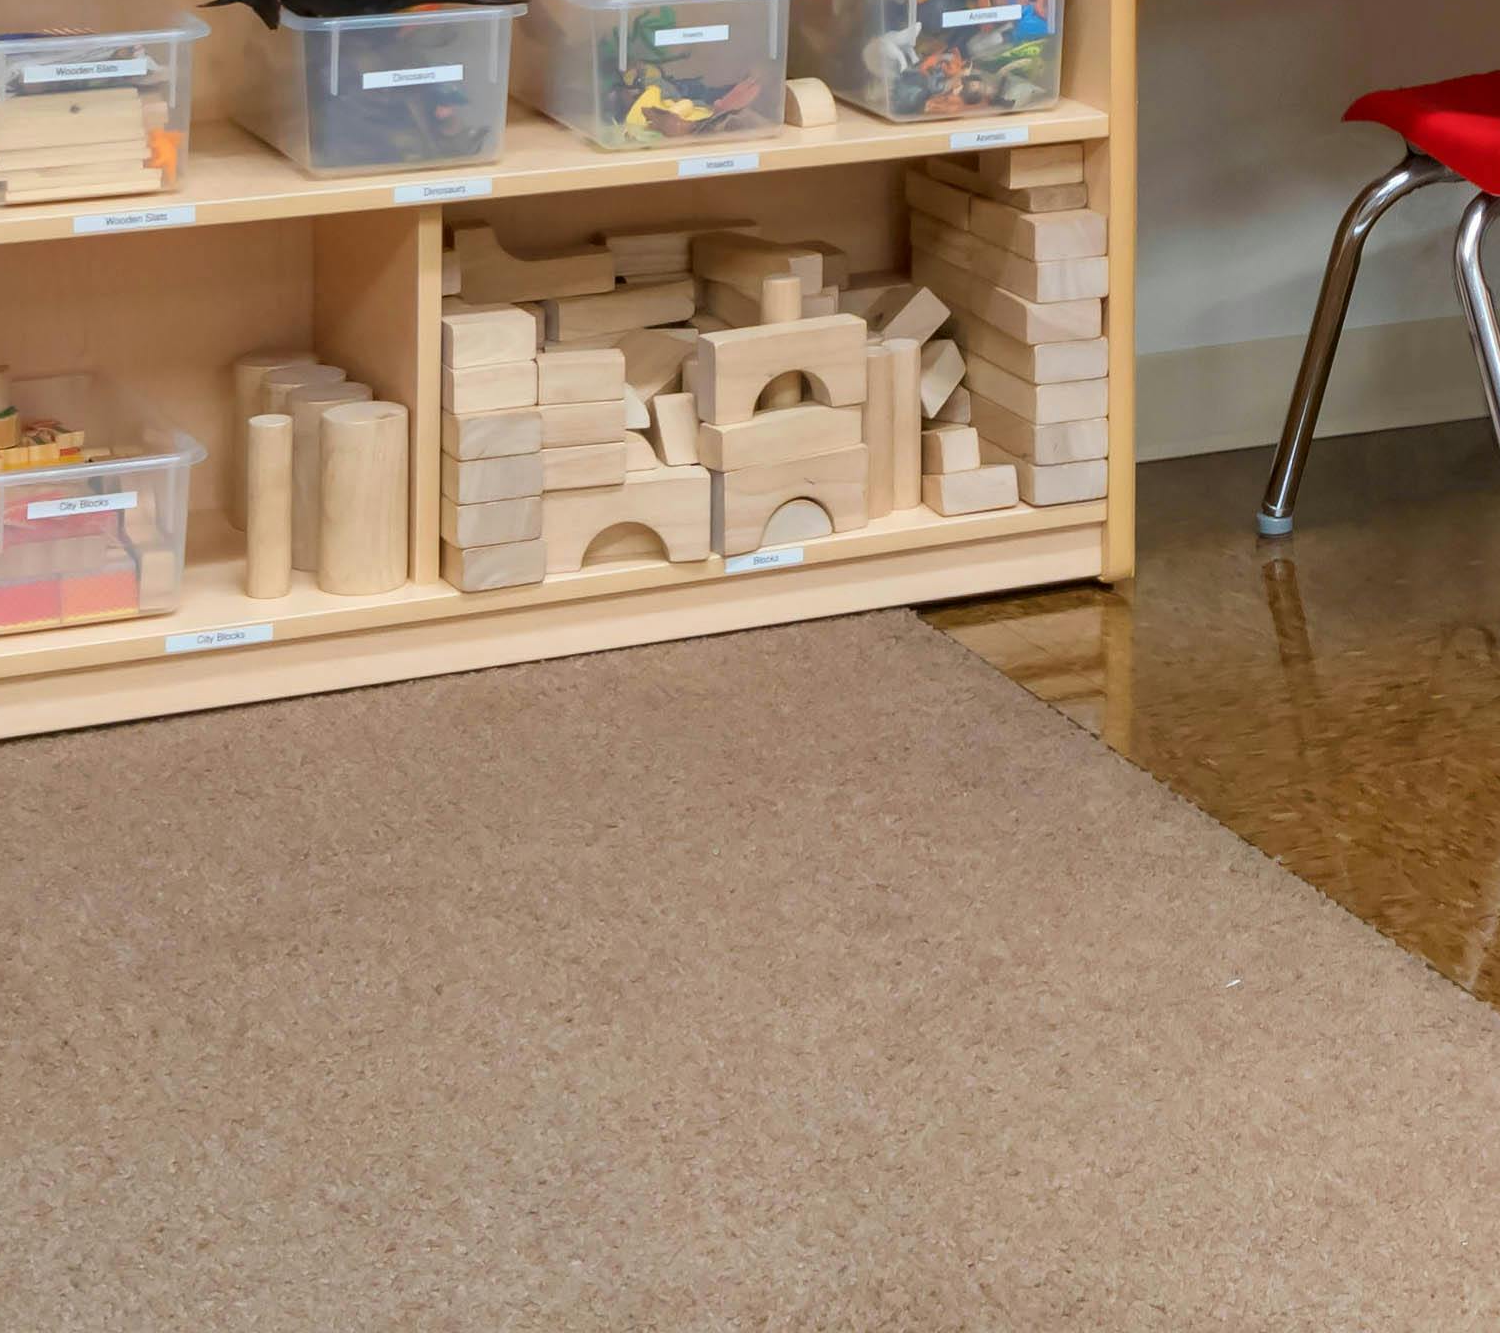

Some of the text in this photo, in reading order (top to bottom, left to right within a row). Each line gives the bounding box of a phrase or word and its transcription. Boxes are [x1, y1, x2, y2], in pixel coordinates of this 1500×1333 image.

[55, 66, 95, 77] Wooden
[105, 212, 168, 227] Wooden Slats
[59, 497, 110, 512] City Blocks
[196, 630, 246, 646] City Blocks
